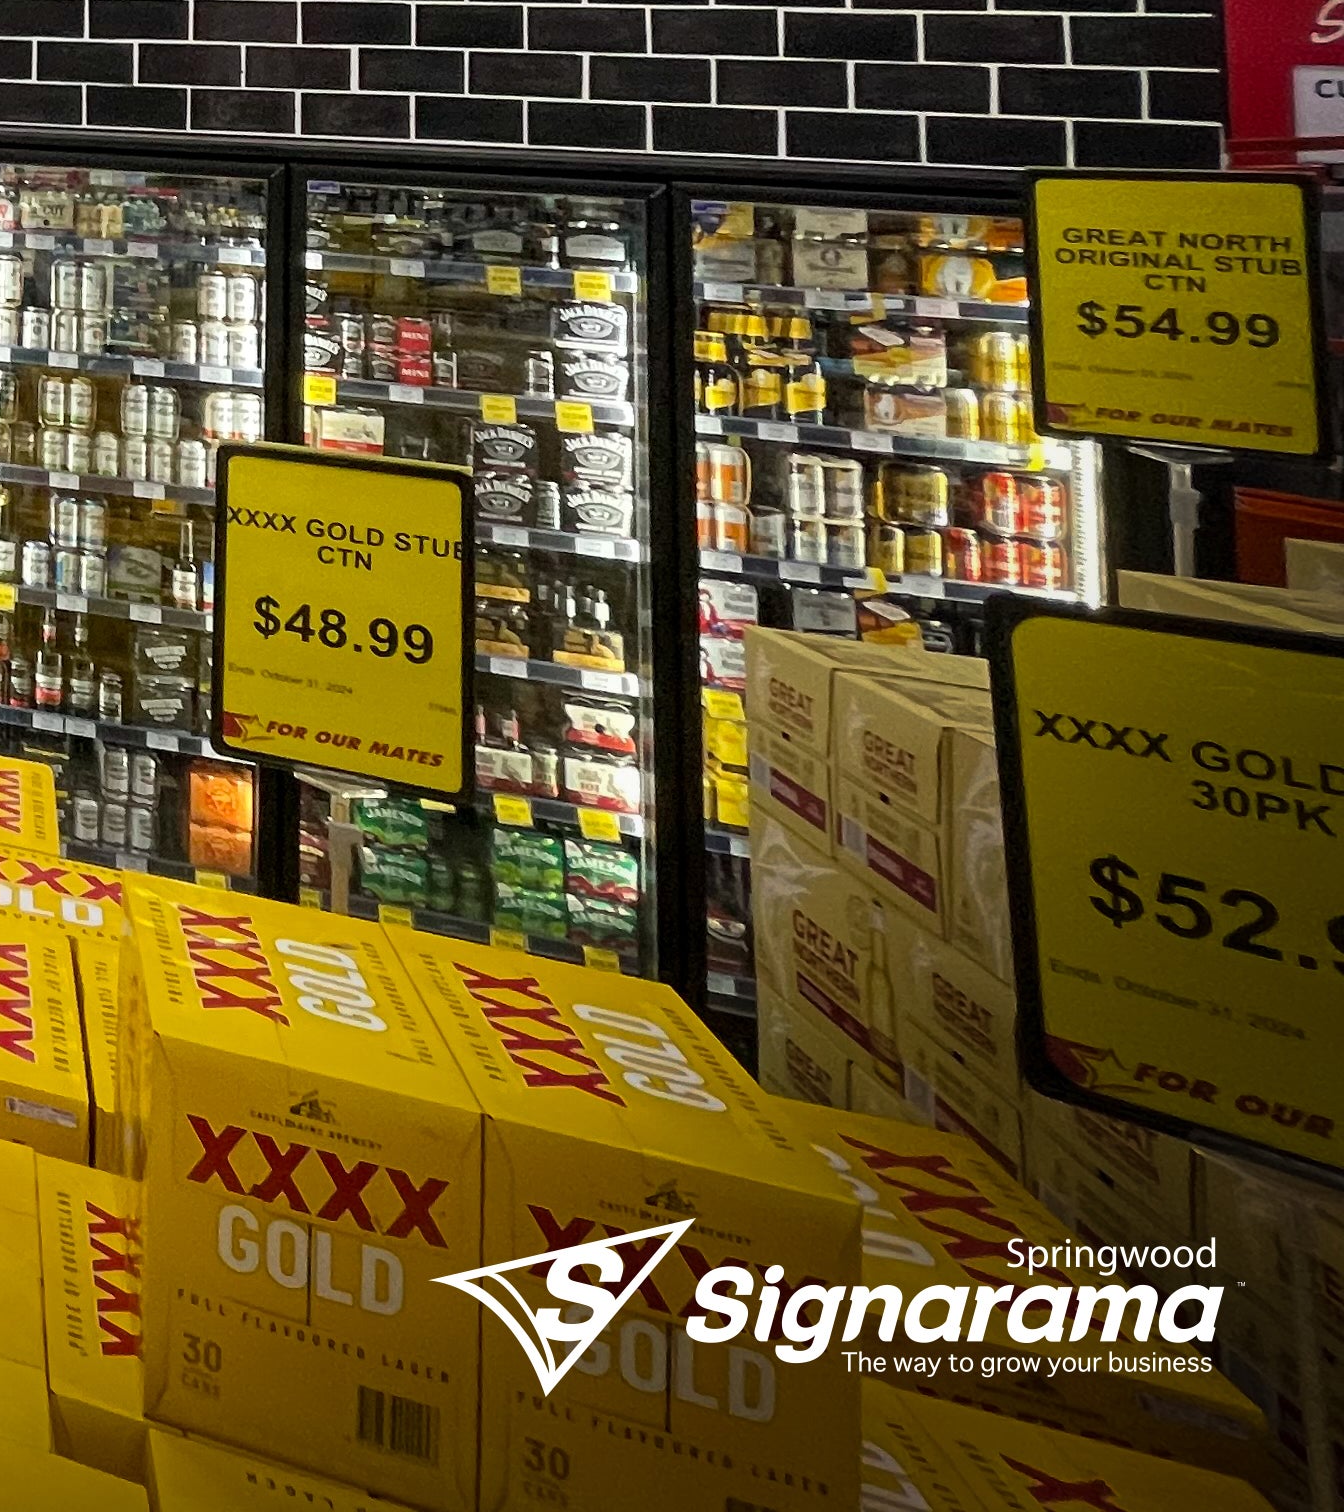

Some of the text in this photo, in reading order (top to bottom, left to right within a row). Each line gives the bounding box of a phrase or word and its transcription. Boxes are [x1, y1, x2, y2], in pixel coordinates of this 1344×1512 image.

[1055, 247, 1303, 277] ORIGINAL STUB
[1062, 227, 1292, 253] GREAT NORTH
[1144, 272, 1207, 294] CTN
[1078, 300, 1281, 349] $54.99
[226, 505, 297, 534] XXXX
[306, 517, 385, 548] GOLD
[317, 545, 373, 572] CTN
[253, 594, 434, 665] $48.99
[265, 719, 445, 769] FOR OUR MATES
[1034, 708, 1174, 764] XXXX
[1190, 778, 1339, 839] 30PK
[177, 903, 292, 1028] XXXX
[792, 908, 860, 974] GREAT
[274, 937, 389, 1032] GOLD
[450, 960, 629, 1109] XXXX
[571, 1002, 729, 1113] GOLD
[1132, 1061, 1336, 1140] FOR OUR
[185, 1112, 451, 1251] XXXX
[217, 1204, 405, 1316] GOLD
[182, 1331, 223, 1374] 30
[523, 1435, 571, 1482] 30
